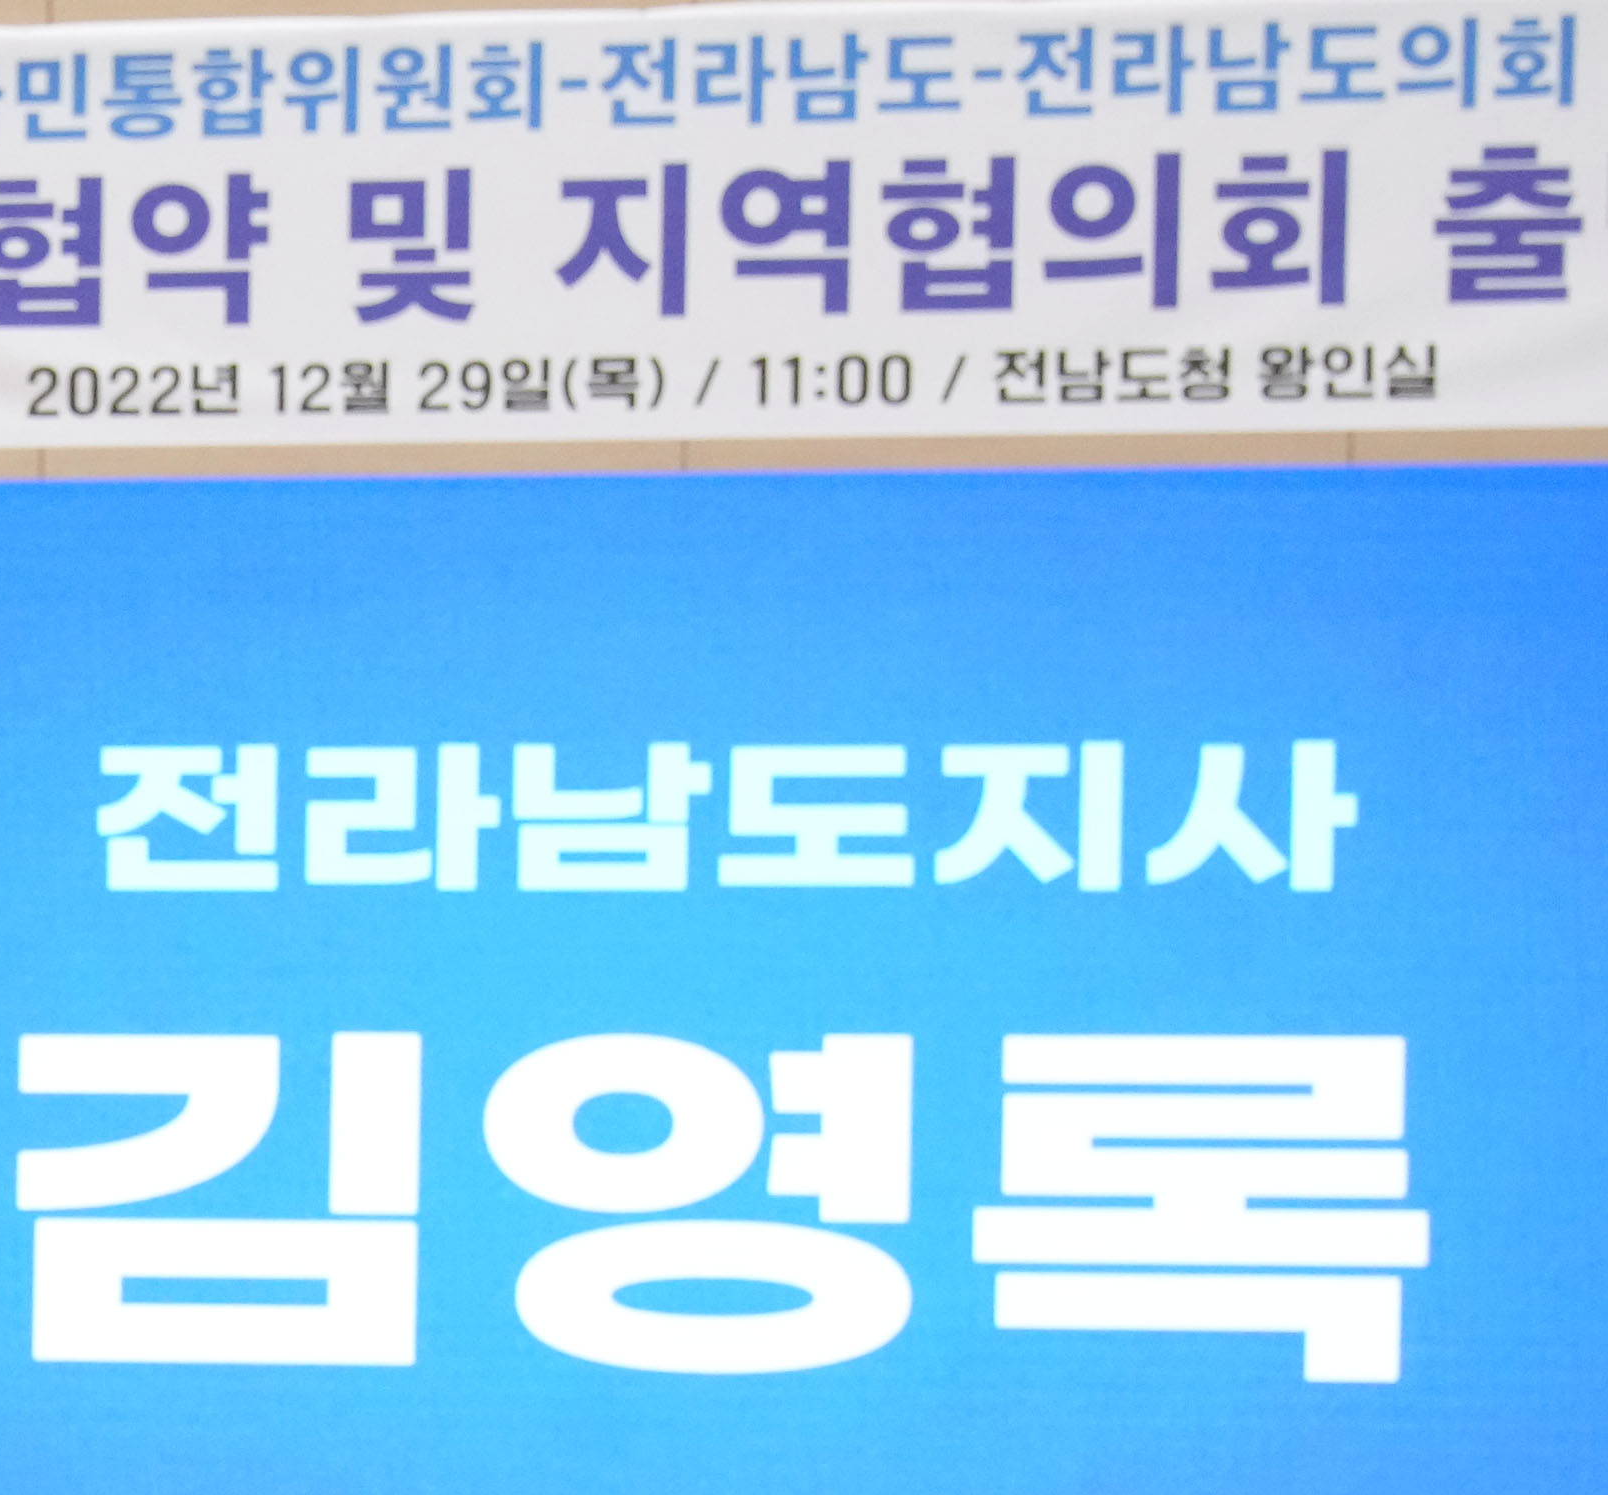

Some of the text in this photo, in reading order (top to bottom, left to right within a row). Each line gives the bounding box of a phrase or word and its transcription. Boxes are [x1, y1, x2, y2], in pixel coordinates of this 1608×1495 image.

[349, 168, 473, 323] 및
[556, 149, 1349, 316] 지역협의회
[1434, 146, 1583, 302] 출
[27, 363, 239, 418] 2022년
[271, 359, 391, 415] 12월
[418, 354, 667, 413] 29일(목)
[751, 353, 914, 406] 11:00
[994, 347, 1233, 404] 전남도청
[1258, 343, 1438, 400] 왕인실
[96, 740, 1359, 892] 전라남도지사
[15, 1030, 1432, 1384] 김영록
